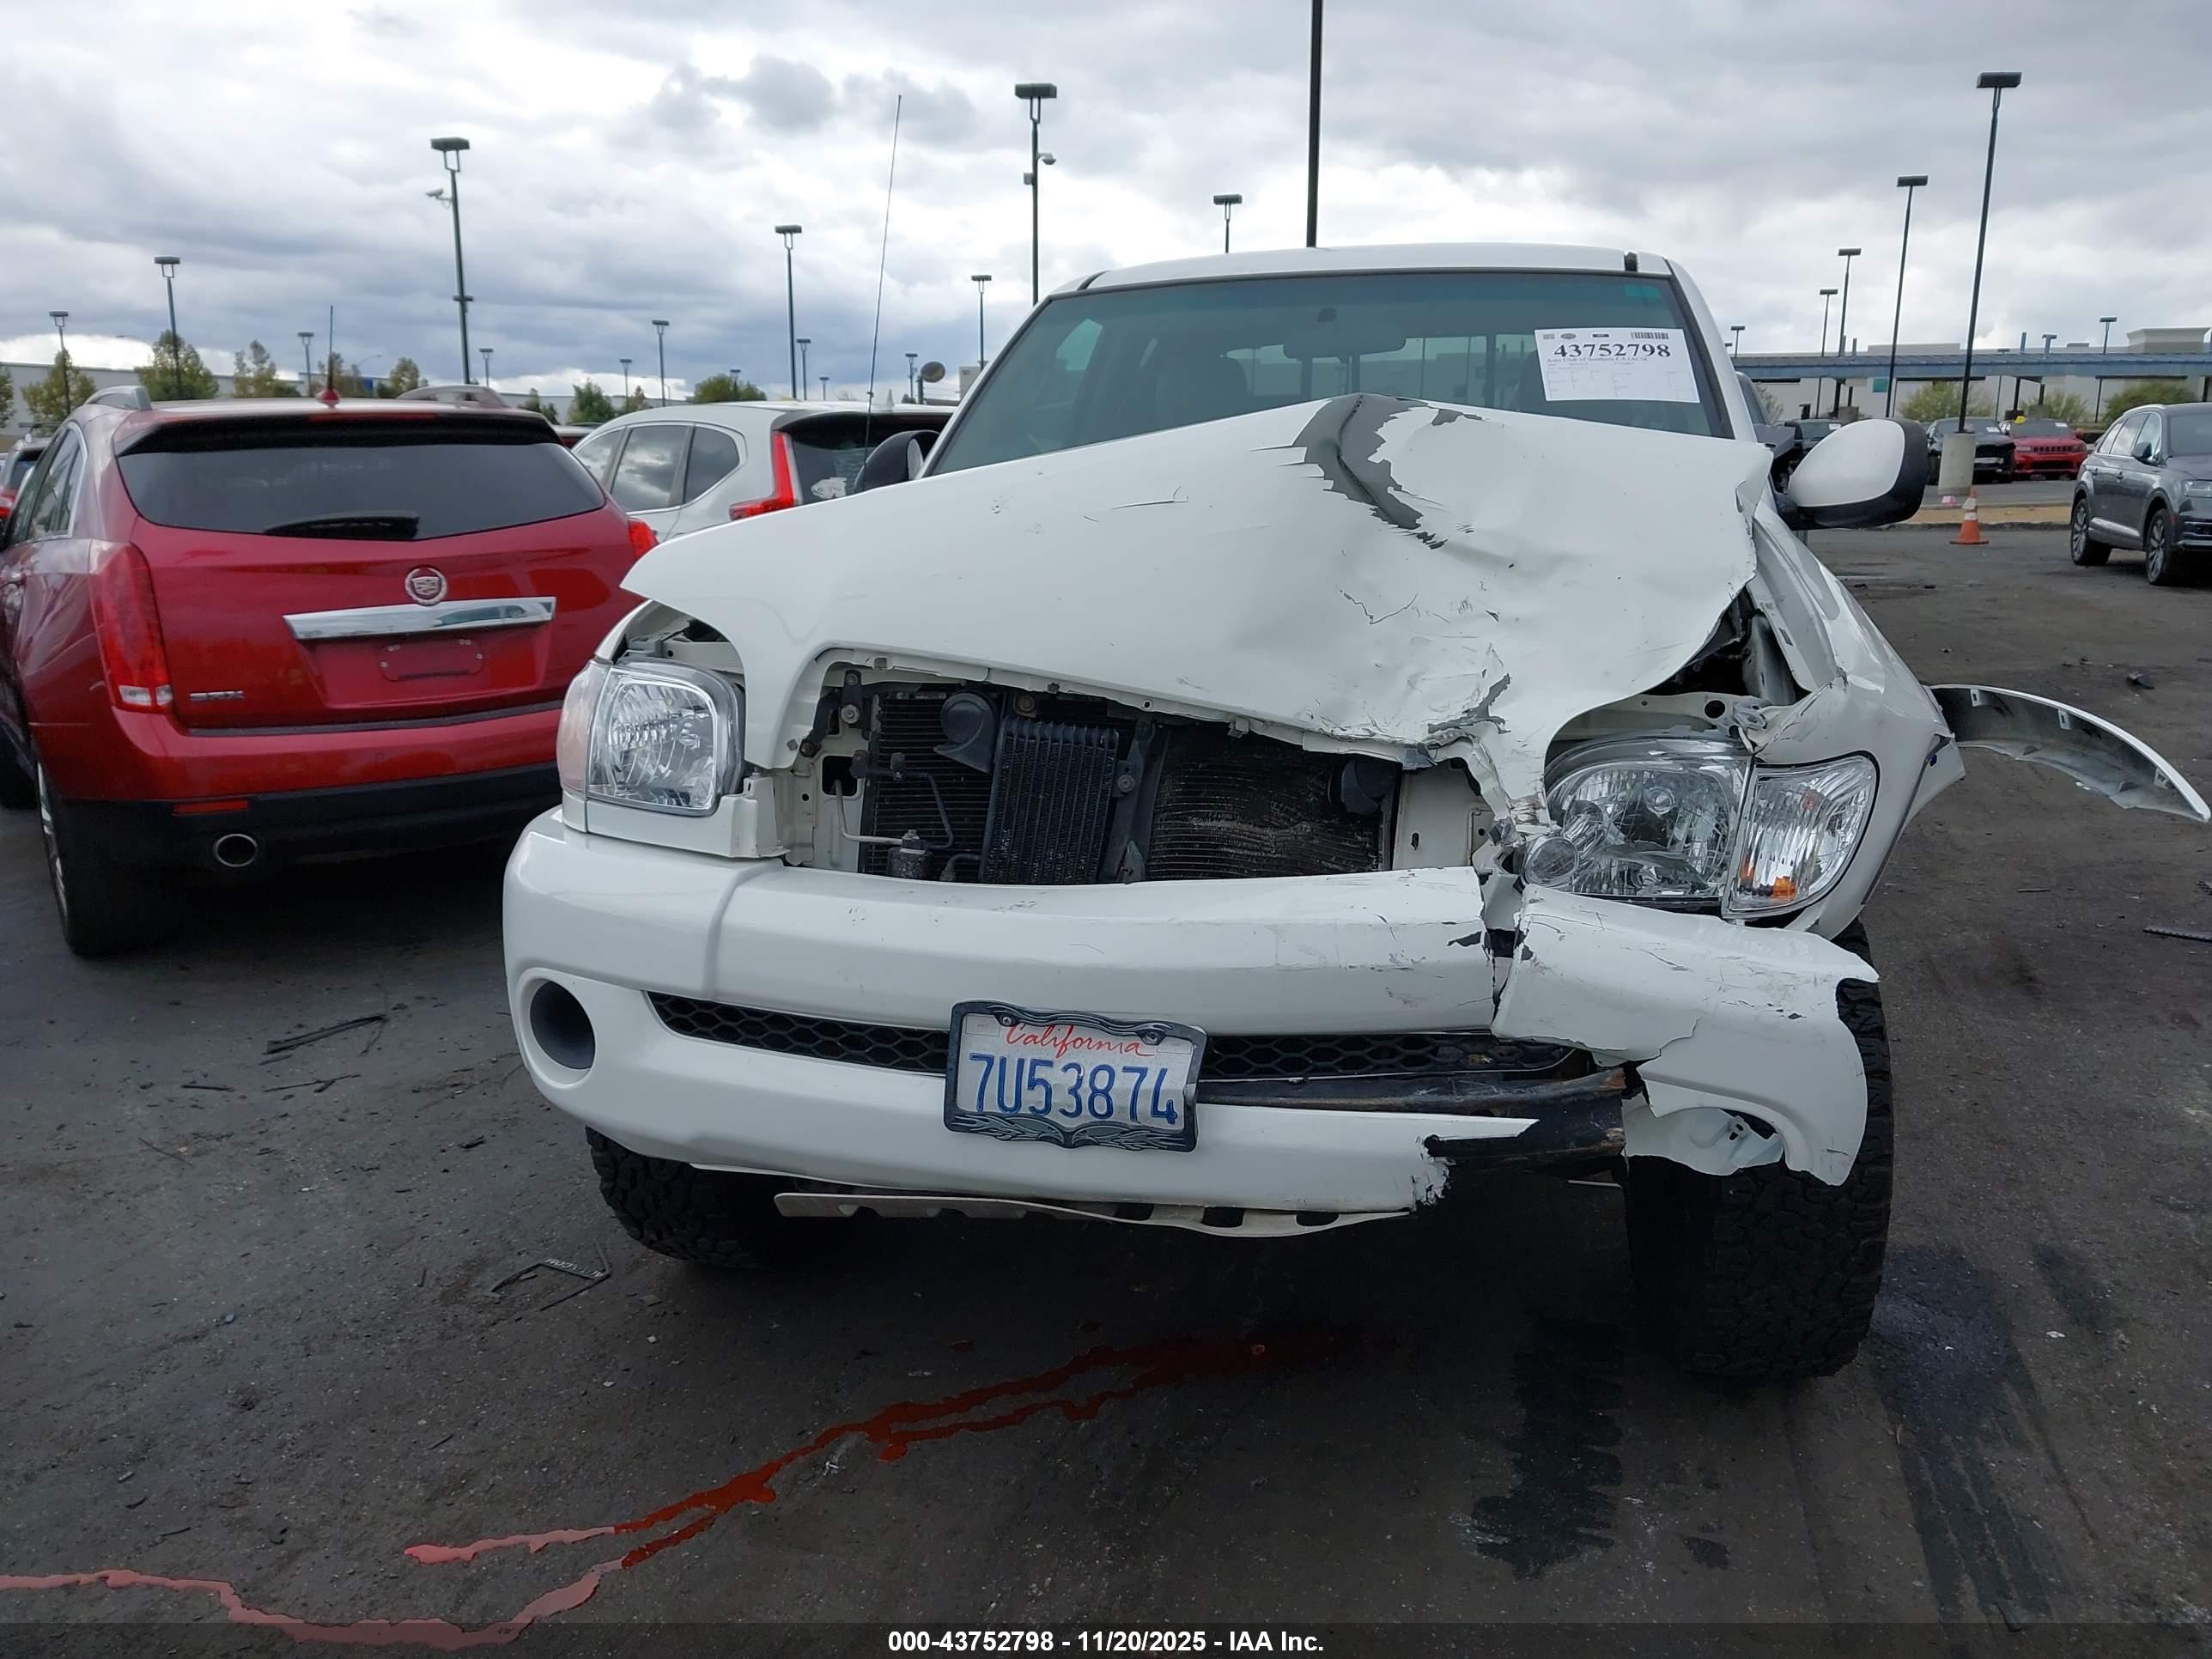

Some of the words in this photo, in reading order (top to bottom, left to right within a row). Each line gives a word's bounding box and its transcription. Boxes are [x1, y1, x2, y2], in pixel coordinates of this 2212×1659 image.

[1554, 343, 1671, 358] 43752798
[1005, 1023, 1155, 1059] California
[969, 1052, 1178, 1125] 7U53874
